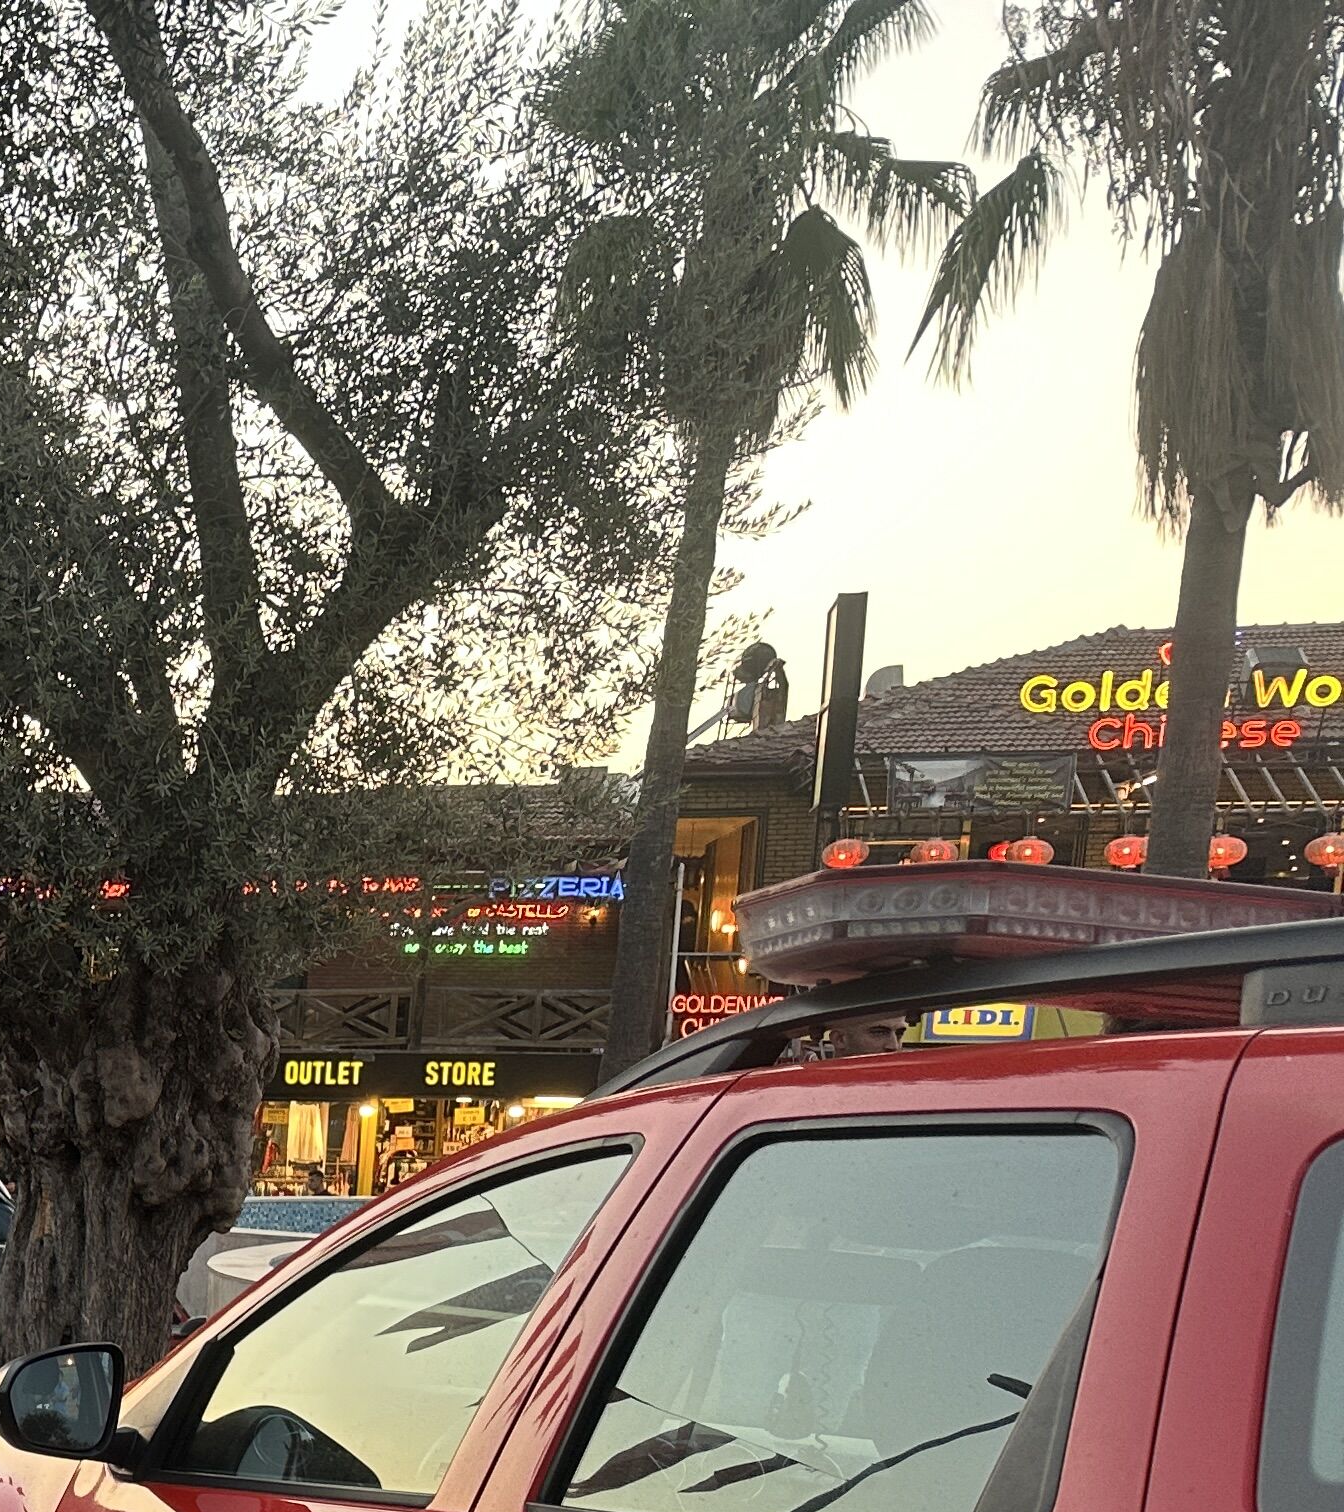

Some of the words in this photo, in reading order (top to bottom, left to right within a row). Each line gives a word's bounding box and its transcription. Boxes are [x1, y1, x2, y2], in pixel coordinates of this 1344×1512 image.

[1020, 669, 1232, 713] Gold
[1088, 713, 1301, 750] Chise
[488, 872, 625, 900] PIZZERIA
[672, 993, 752, 1014] GOLDEN
[285, 1060, 364, 1086] OUTLET
[424, 1060, 496, 1087] STORE
